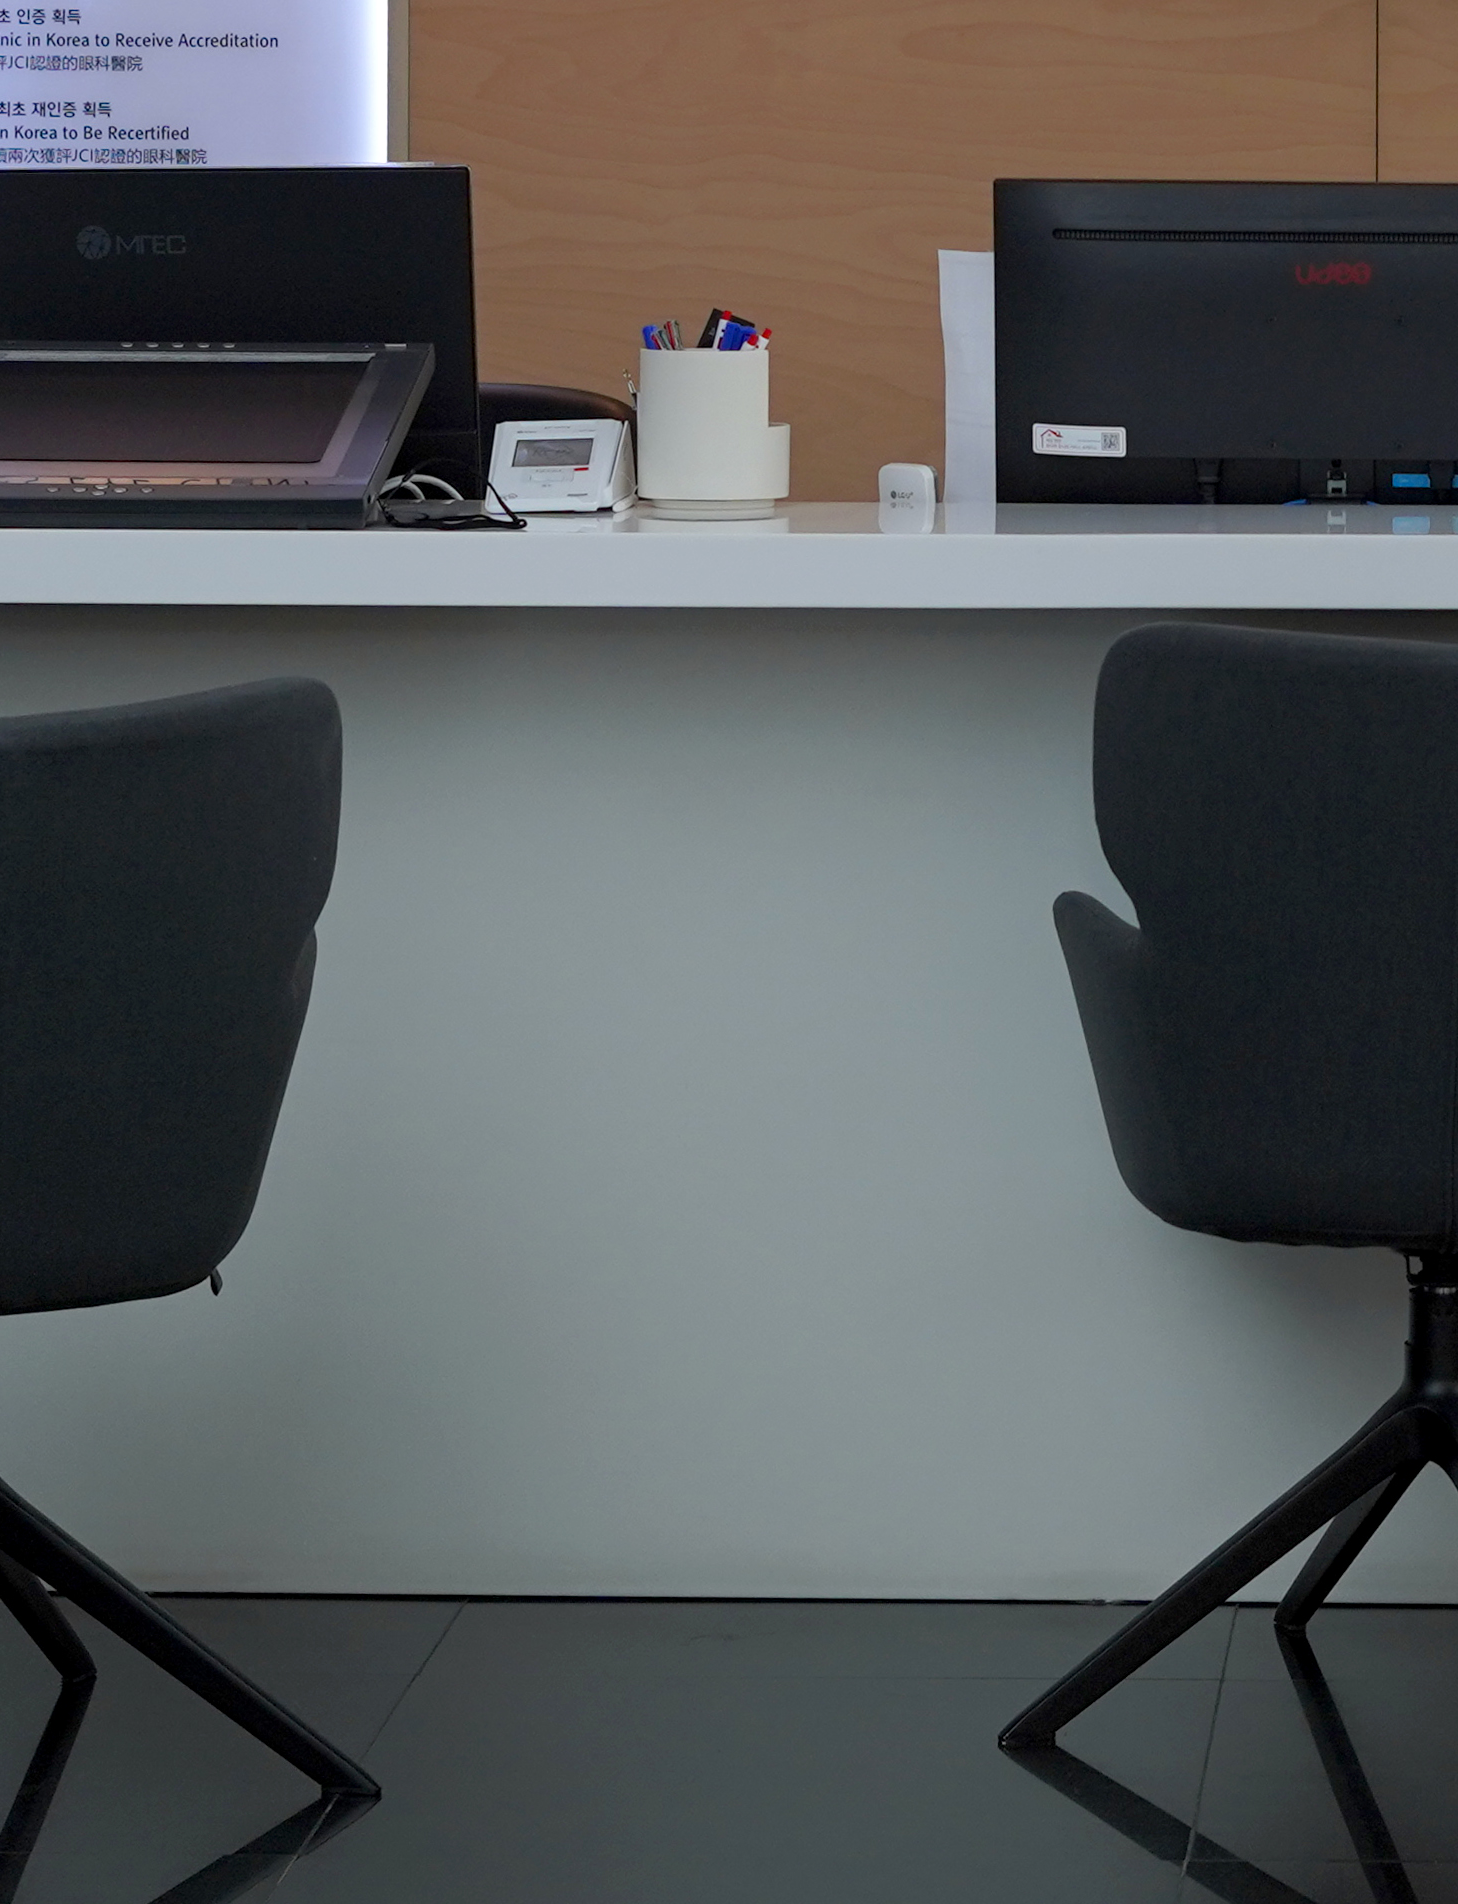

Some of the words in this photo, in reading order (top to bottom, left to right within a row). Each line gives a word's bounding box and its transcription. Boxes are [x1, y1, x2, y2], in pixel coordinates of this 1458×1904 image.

[16, 8, 46, 26] 인증
[51, 8, 82, 26] 획득
[27, 31, 41, 47] in
[46, 32, 90, 48] Korea
[94, 34, 110, 48] to
[115, 32, 174, 48] Receive
[177, 32, 279, 48] Accreditation
[31, 101, 77, 119] 재인증
[82, 101, 112, 118] 획득
[14, 125, 58, 140] Korea
[62, 126, 79, 140] to
[83, 125, 103, 140] Be
[108, 125, 190, 141] Recertified
